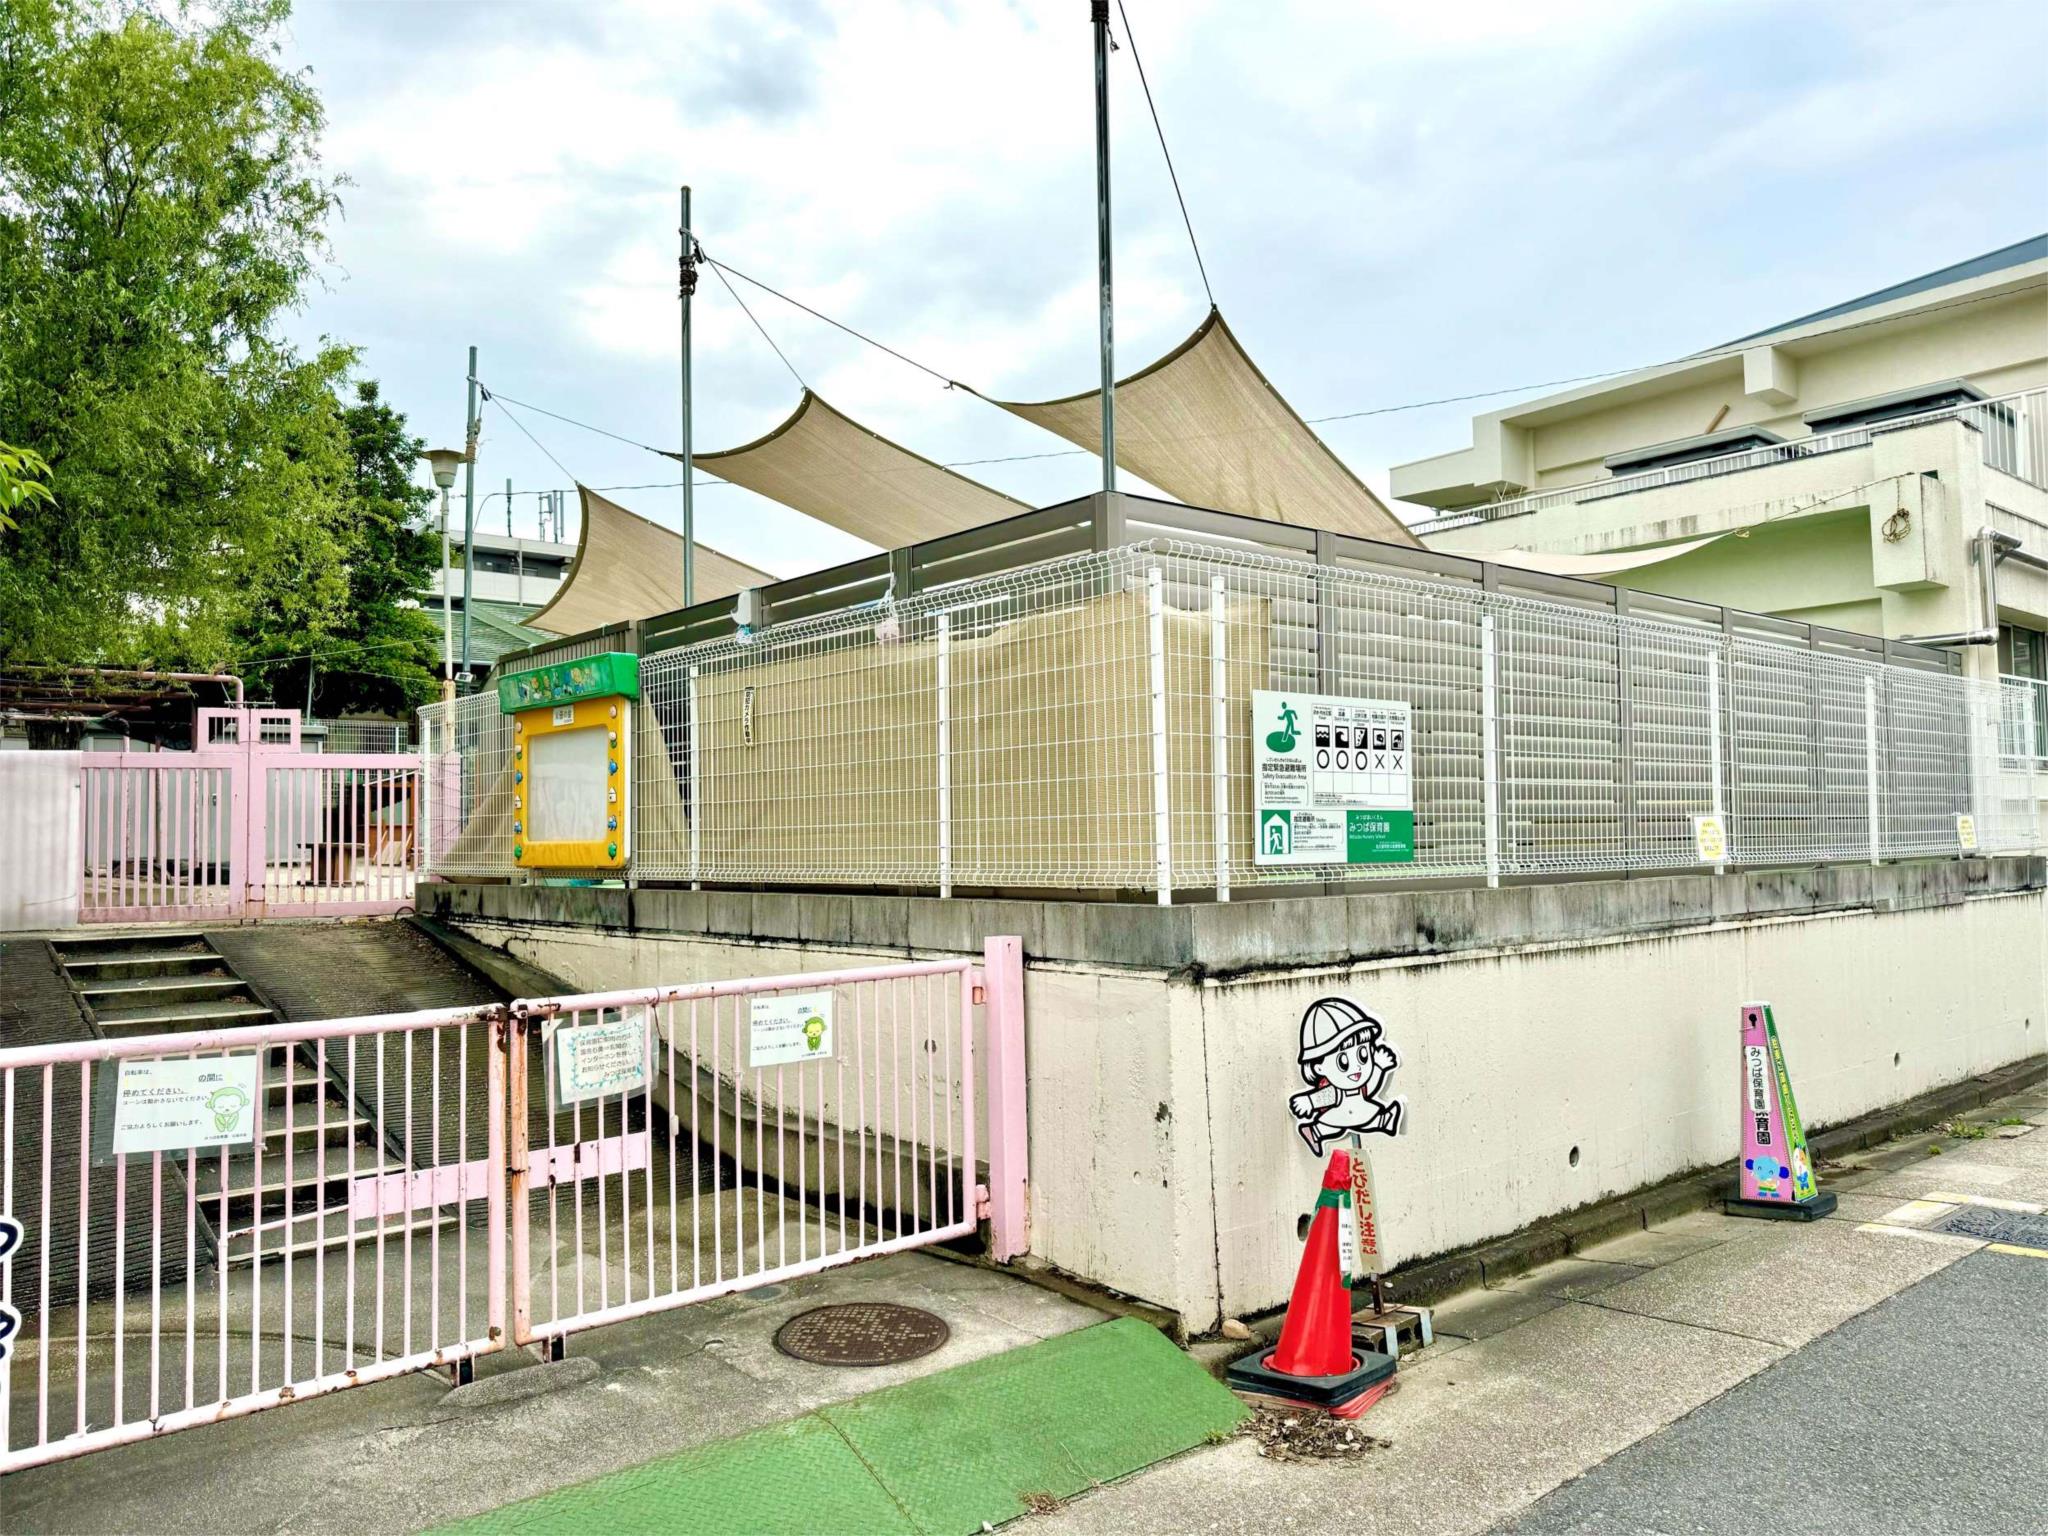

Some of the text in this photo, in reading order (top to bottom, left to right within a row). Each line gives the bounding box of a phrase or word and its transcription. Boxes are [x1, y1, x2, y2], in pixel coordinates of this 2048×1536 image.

[1262, 763, 1307, 772] 指定緊急避難場所
[1349, 822, 1390, 832] みつば保育園
[198, 1073, 224, 1082] の間に
[1750, 1047, 1766, 1109] みつば保育園
[1755, 1113, 1771, 1144] 育園
[1352, 1157, 1377, 1255] とびだし注意
